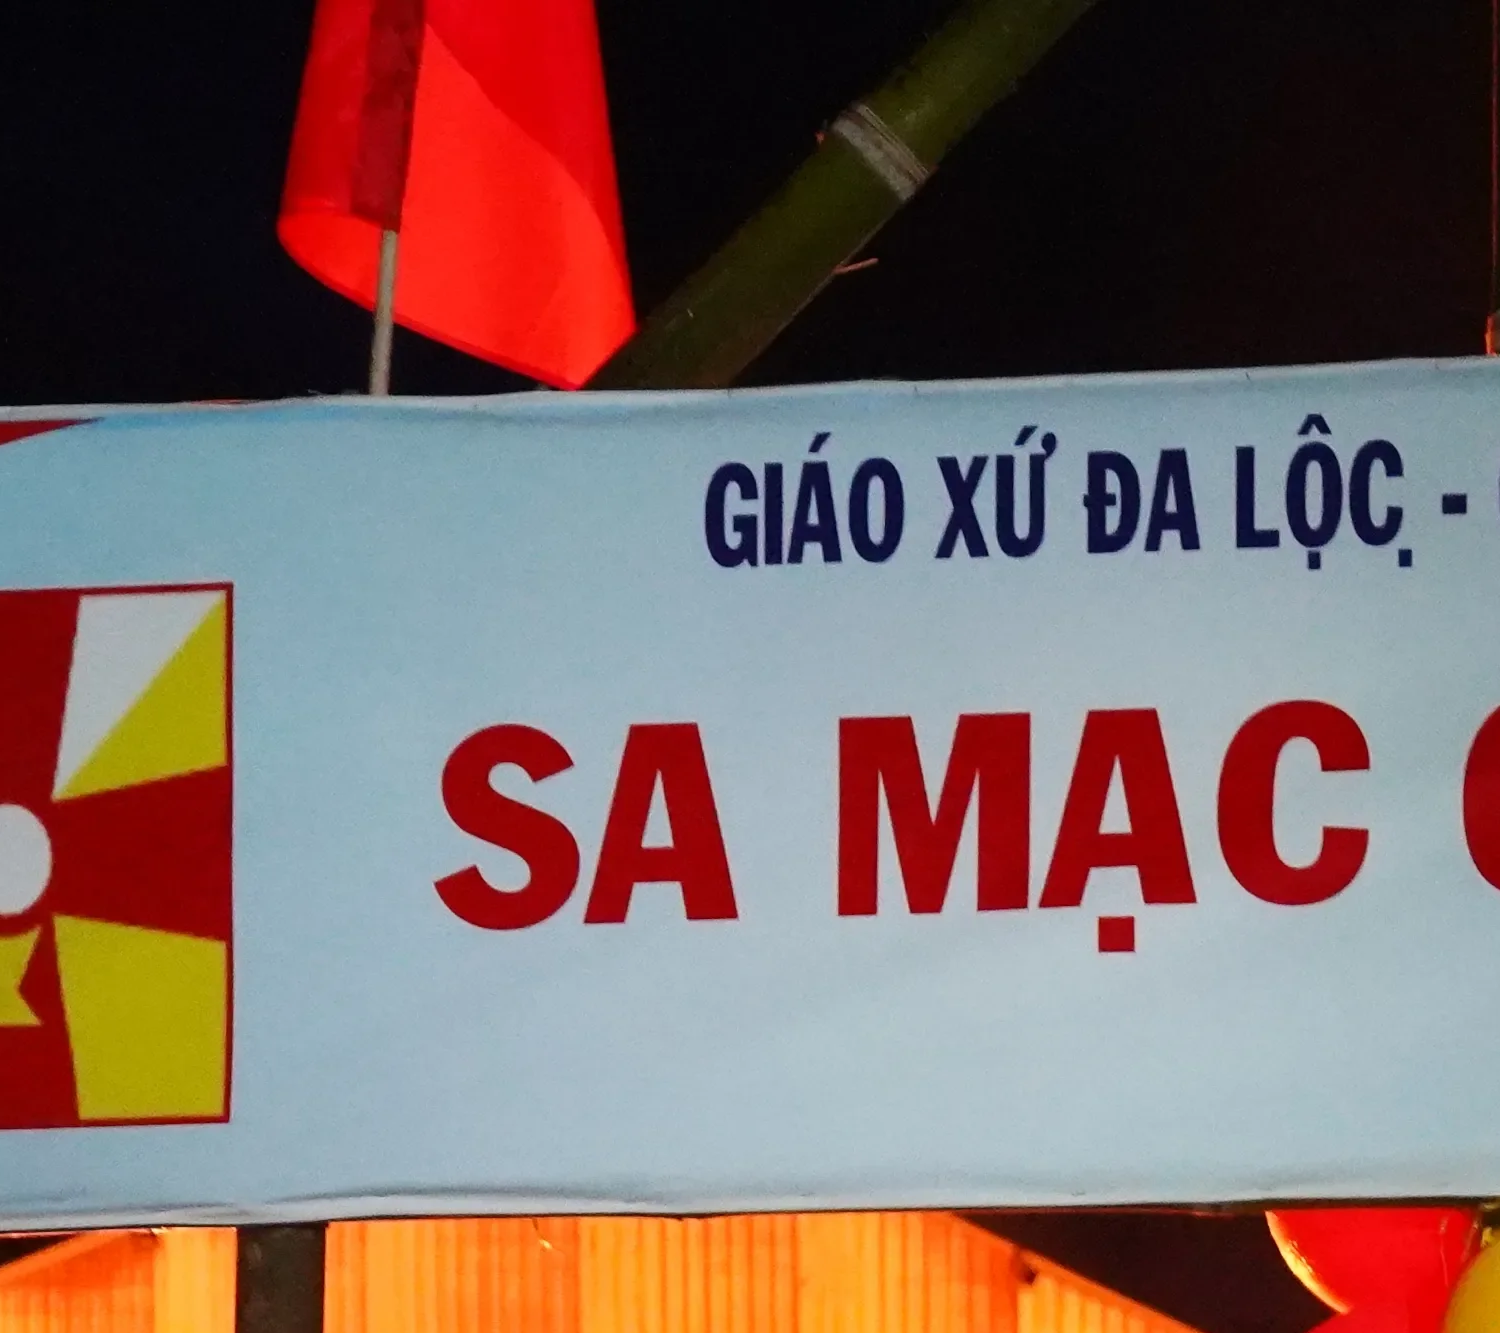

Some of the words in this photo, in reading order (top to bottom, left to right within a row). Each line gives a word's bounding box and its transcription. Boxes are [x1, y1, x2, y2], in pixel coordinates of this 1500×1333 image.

[704, 431, 906, 569] GIÁO
[934, 424, 1058, 560] XỨ
[1082, 447, 1202, 555] ĐA
[433, 721, 740, 932] SA
[836, 699, 1372, 954] MẠC
